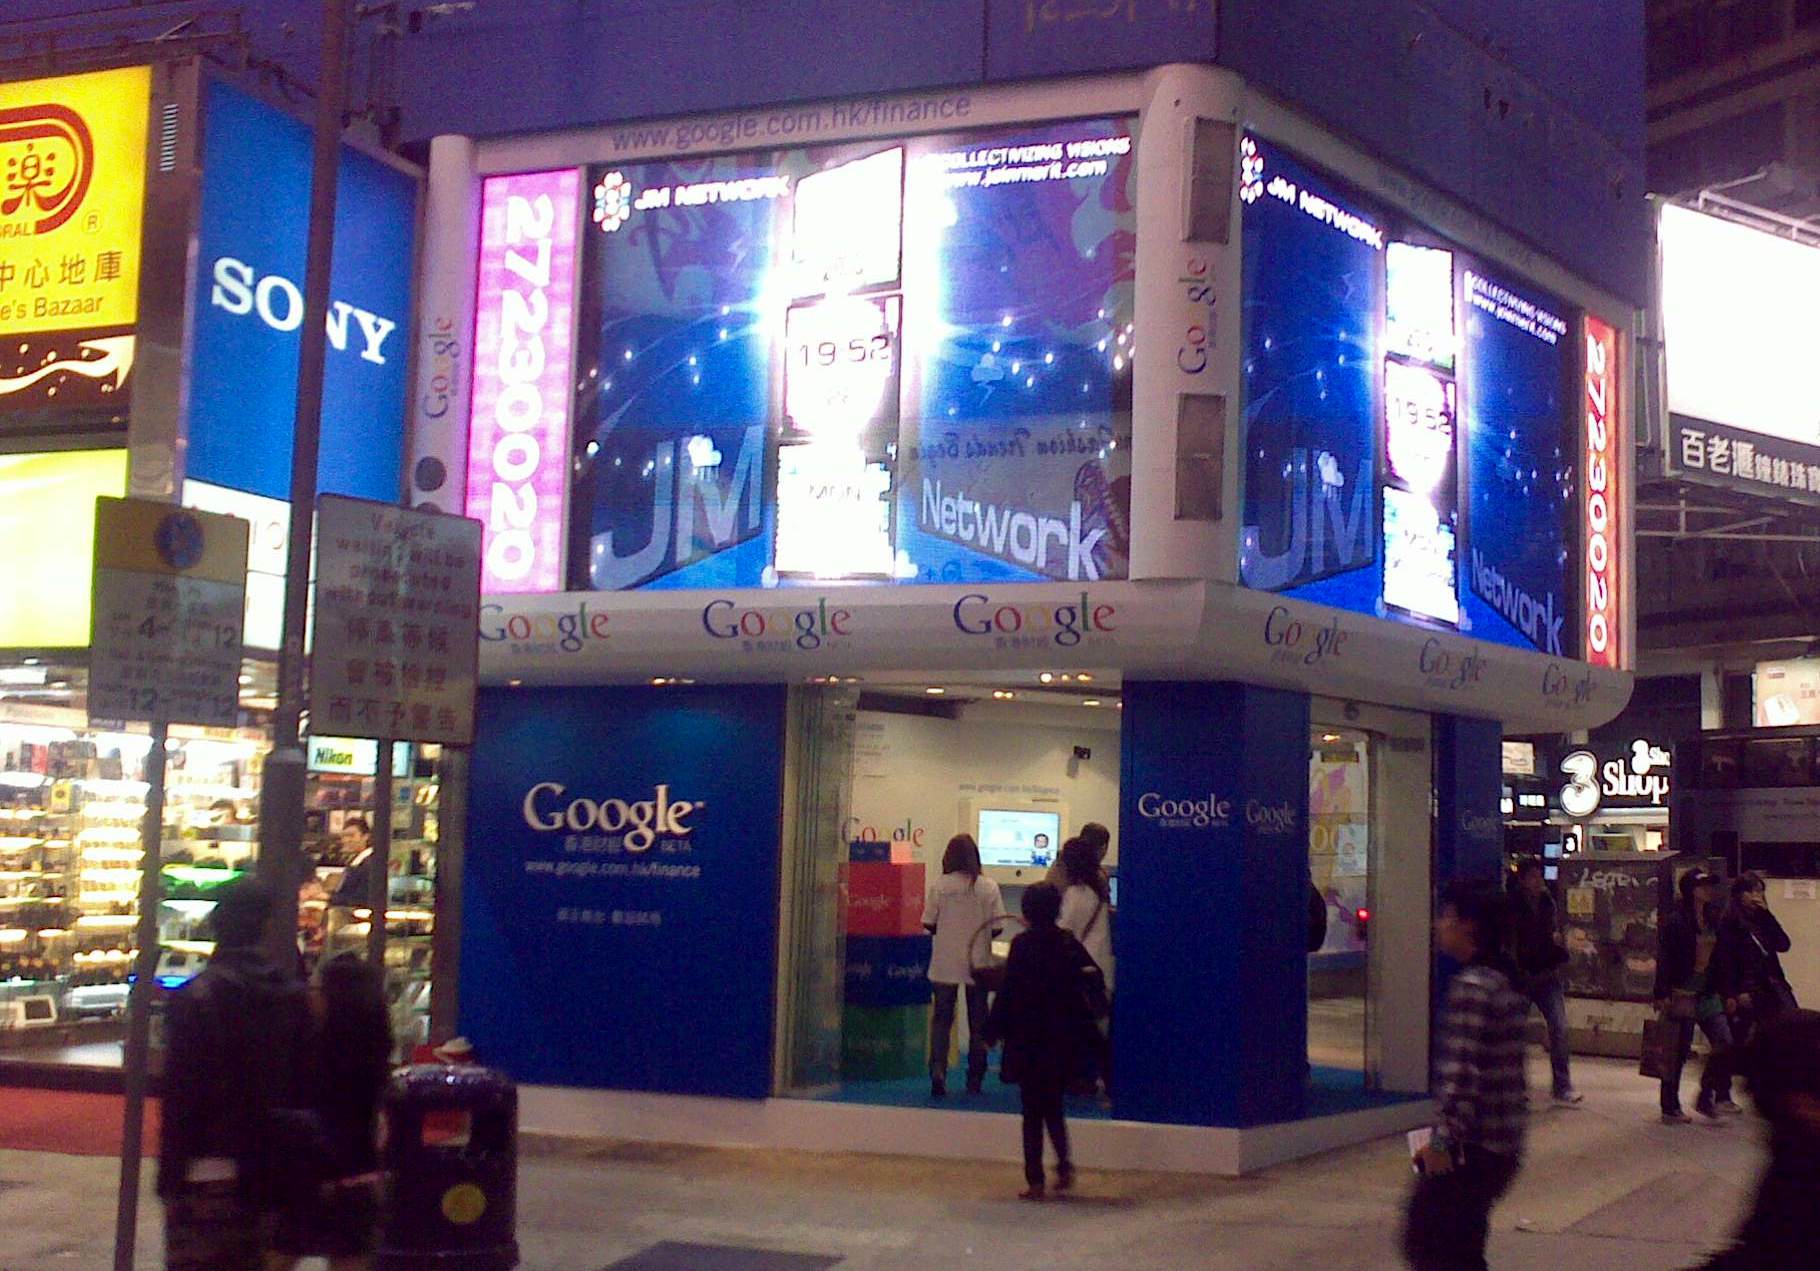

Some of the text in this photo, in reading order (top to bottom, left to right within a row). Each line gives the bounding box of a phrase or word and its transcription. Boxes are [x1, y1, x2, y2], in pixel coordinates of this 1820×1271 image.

[611, 95, 971, 151] www.google.com.hk/finance
[634, 175, 790, 210] JM NETWORK
[1267, 176, 1382, 250] JM NETWORK
[34, 296, 104, 318] Bazaar
[211, 257, 396, 366] SONY
[1177, 258, 1217, 375] Google
[423, 318, 460, 419] Google
[799, 335, 890, 367] 19 52
[486, 193, 554, 581] 27230020
[589, 424, 765, 590] JM
[1240, 447, 1374, 590] JM
[1586, 333, 1608, 653] 27230020
[922, 478, 1107, 581] Network
[477, 601, 612, 653] Google
[702, 597, 852, 651] Google
[952, 591, 1118, 647] Google
[1472, 548, 1565, 657] Network
[1418, 637, 1488, 691] Gogle
[1542, 662, 1598, 704] Gogle
[314, 747, 353, 766] Nikon
[1560, 751, 1669, 816] 3 Shop
[523, 782, 695, 851] Google
[842, 817, 925, 847] Gogle
[1138, 792, 1231, 826] Google
[1245, 799, 1296, 831] Google
